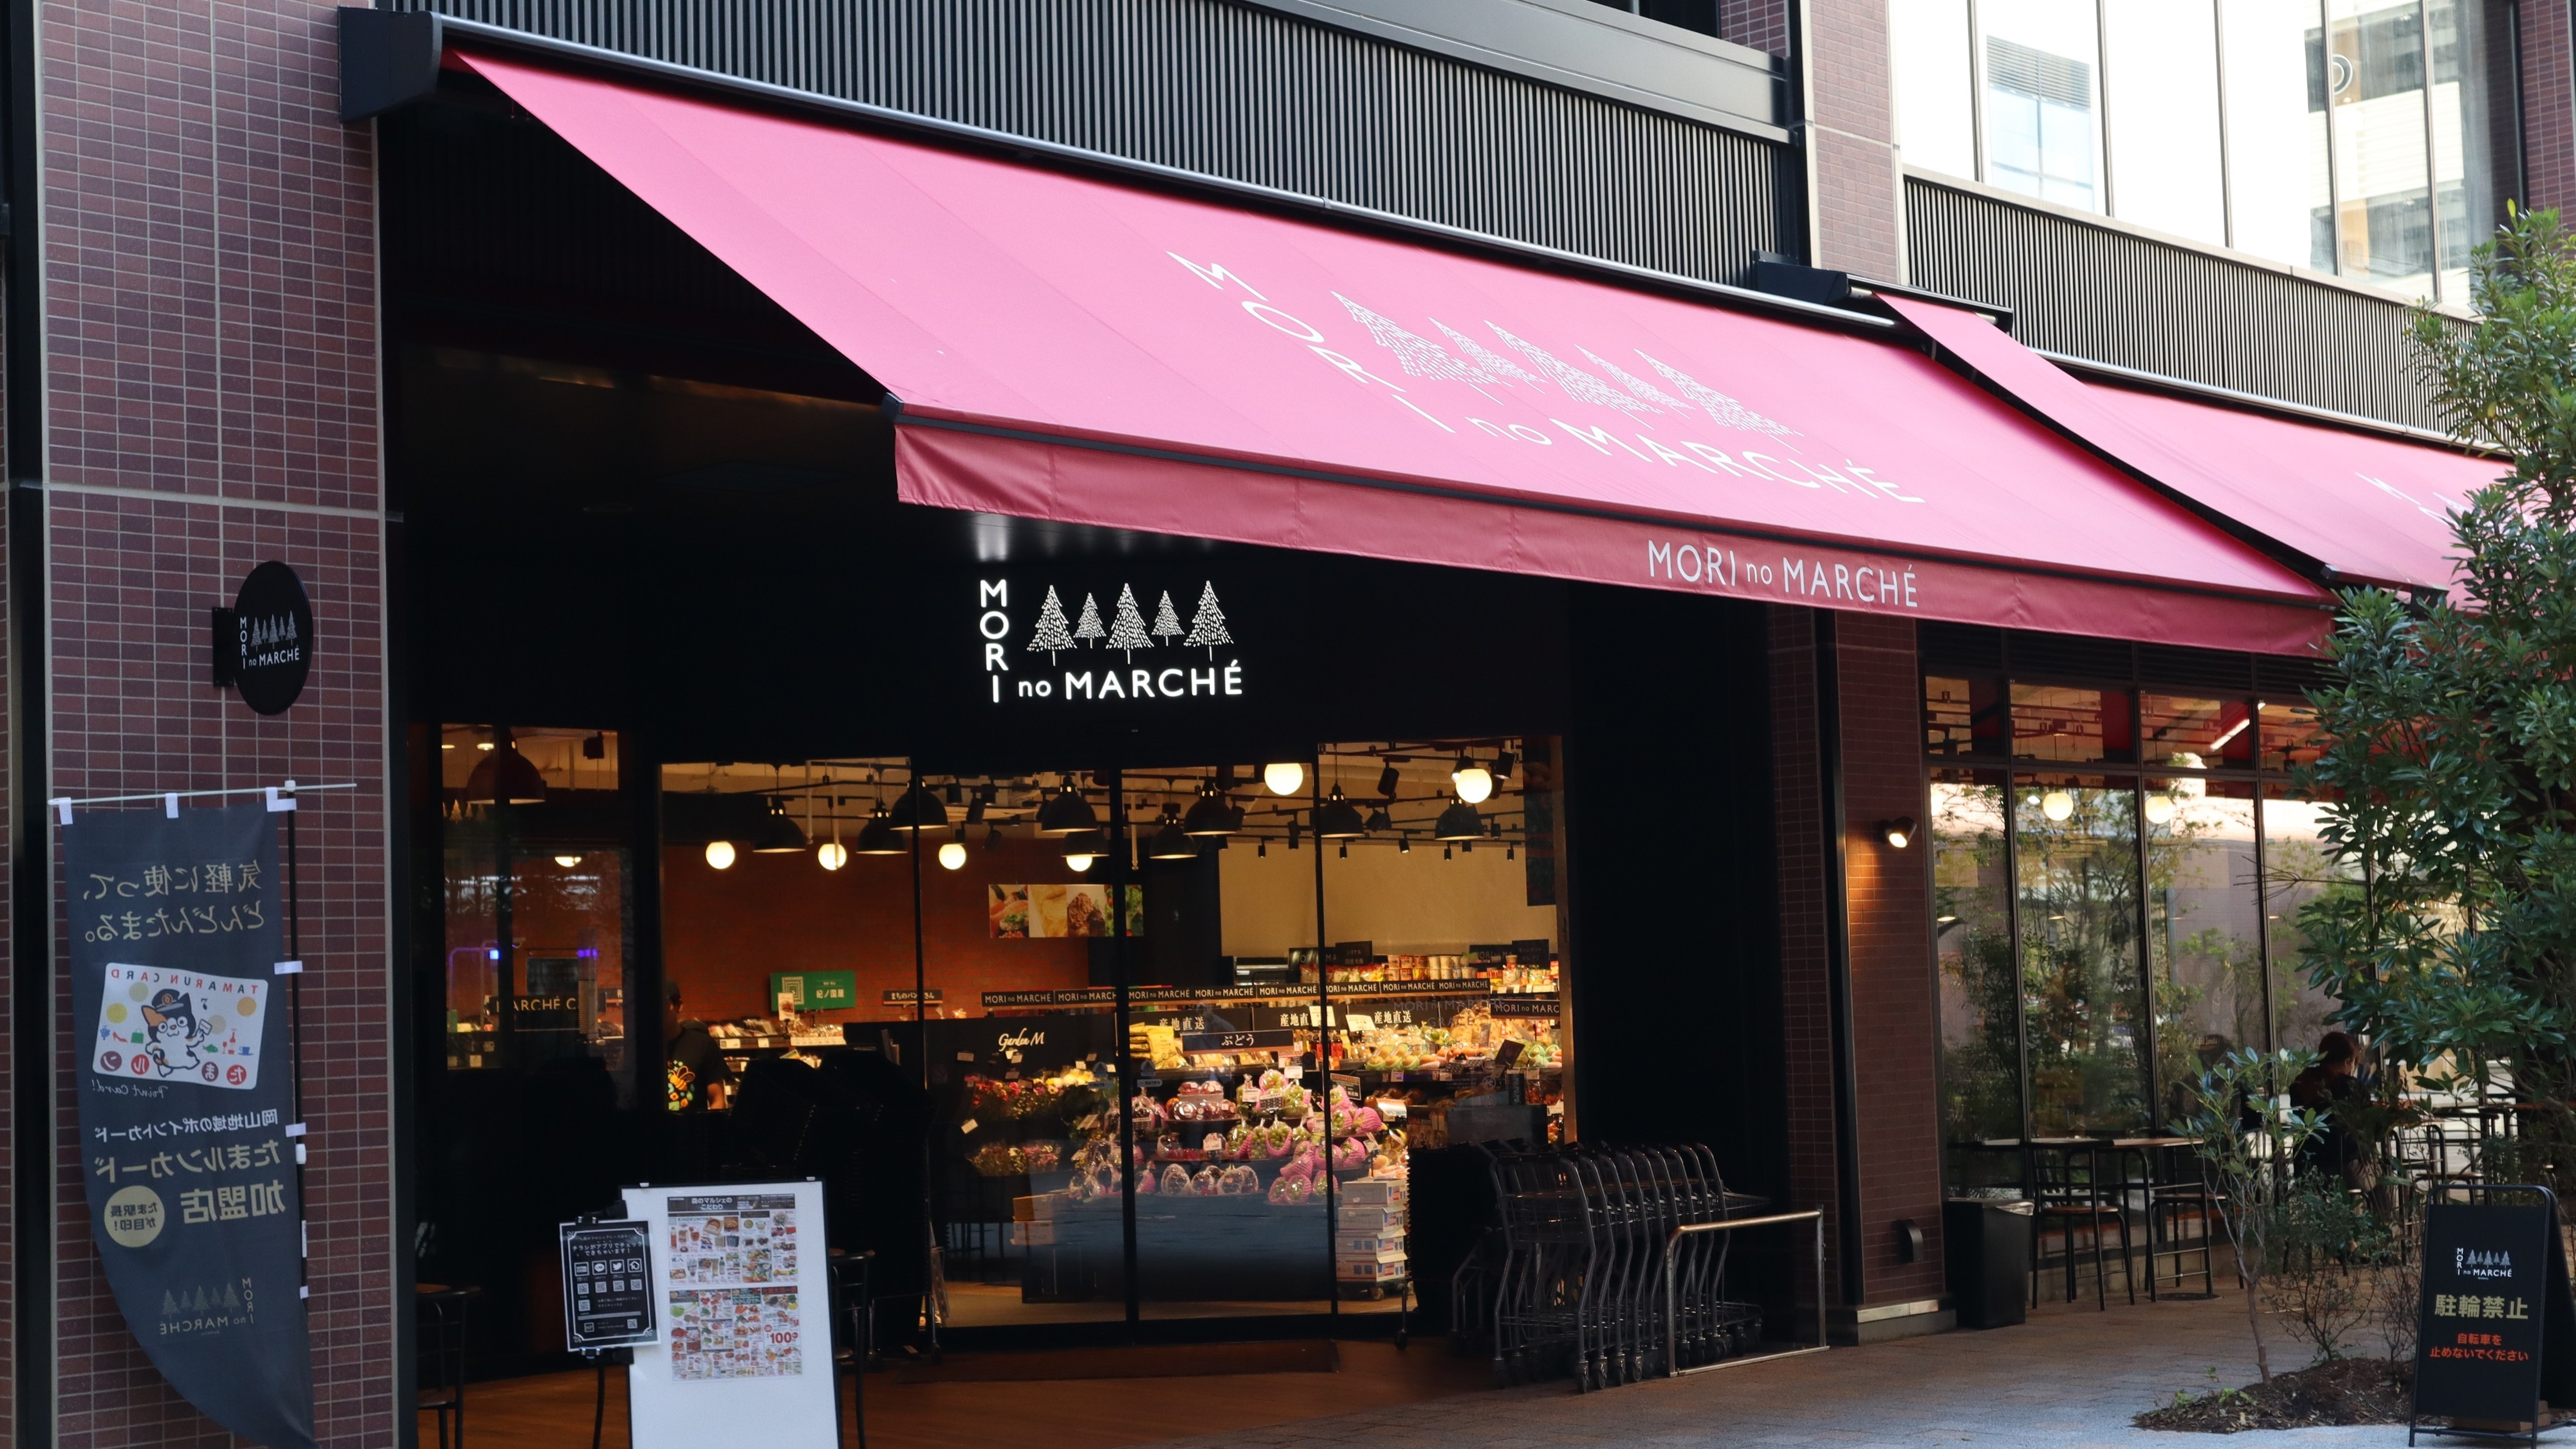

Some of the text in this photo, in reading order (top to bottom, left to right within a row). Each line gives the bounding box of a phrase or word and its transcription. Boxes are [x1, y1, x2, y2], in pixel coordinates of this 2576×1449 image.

[1166, 250, 1926, 503] MORI no MARCHÉ
[1649, 539, 1918, 607] MORI no MARCHÉ
[979, 578, 1243, 703] MORI no MARCHÉ
[249, 658, 256, 666] no
[259, 645, 300, 667] MARCHÉ
[1259, 986, 1278, 995] MORI
[1286, 984, 1317, 995] MARCHÉ
[1348, 982, 1378, 992] MARCHÉ
[1383, 981, 1400, 991] MORI
[1407, 981, 1436, 991] MARCHÉ
[1439, 981, 1455, 989] MORI
[1462, 979, 1489, 989] MARCHÉ
[1058, 993, 1079, 1001] MORI
[1129, 991, 1149, 999] MORI
[1157, 988, 1190, 998] MARCHÉ
[1195, 989, 1214, 998] MORI
[1222, 986, 1254, 996] MARCHÉ
[985, 995, 1006, 1003] MORI
[1016, 994, 1051, 1003] MARCHÉ
[1495, 1003, 1520, 1013] MORI
[1280, 1013, 1311, 1027] 産地直
[1373, 1010, 1412, 1023] 産地直送
[1427, 1016, 1475, 1027] GRACE
[1159, 1016, 1205, 1030] 産地直送
[998, 1027, 1044, 1051] Garden M
[1221, 1033, 1255, 1046] ぶどう
[2472, 1268, 2513, 1277] MARCHÉ
[2435, 1294, 2528, 1320] 駐輪禁止
[2458, 1333, 2502, 1345] 自転車を
[2430, 1347, 2529, 1361] 止めないでください
